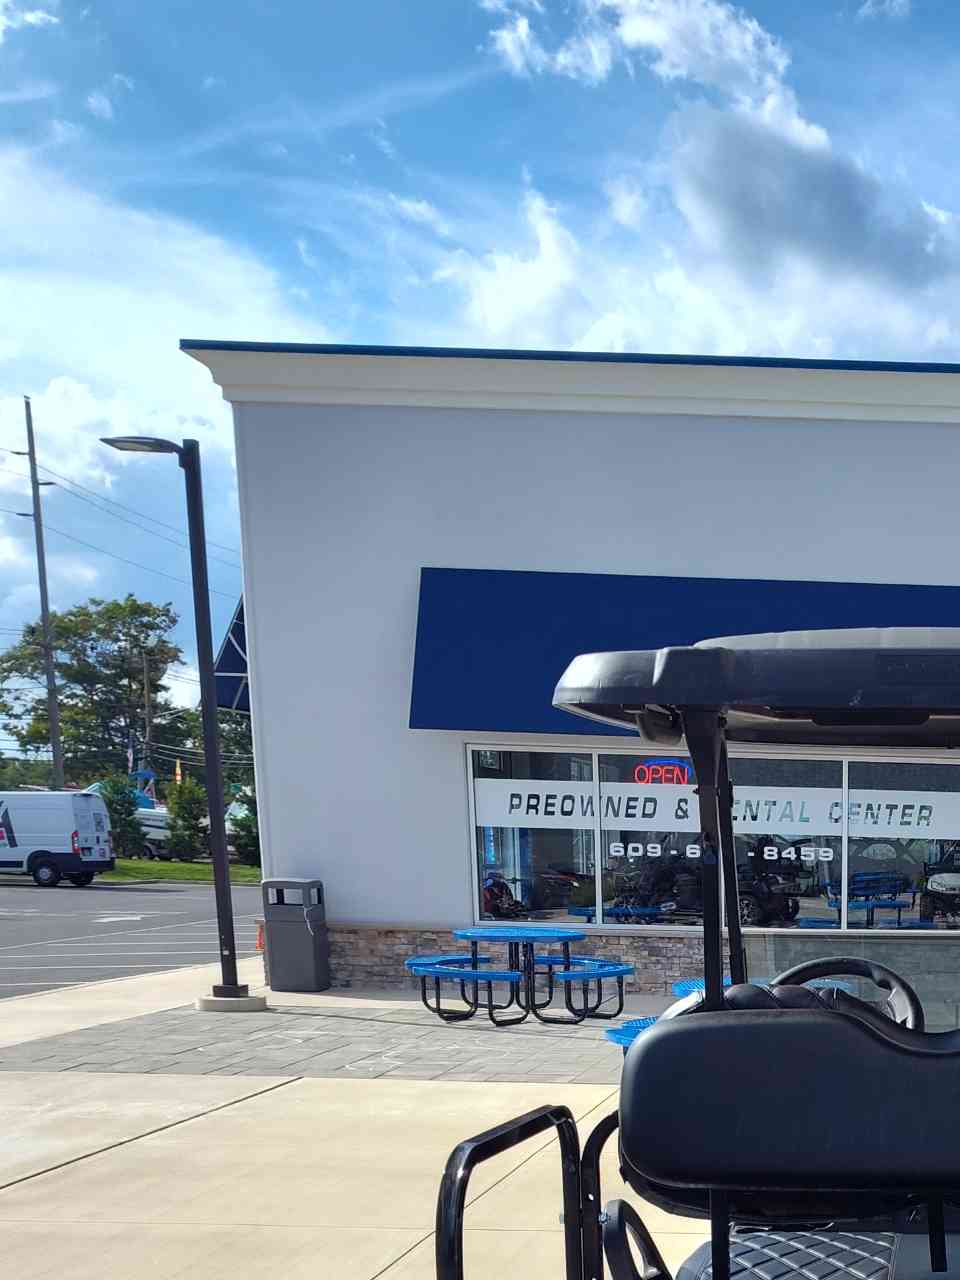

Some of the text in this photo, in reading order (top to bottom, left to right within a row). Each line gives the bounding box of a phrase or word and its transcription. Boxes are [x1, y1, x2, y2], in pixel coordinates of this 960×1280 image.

[634, 765, 688, 784] OPEN
[509, 793, 934, 827] PREOWNED & NTAL CENTER
